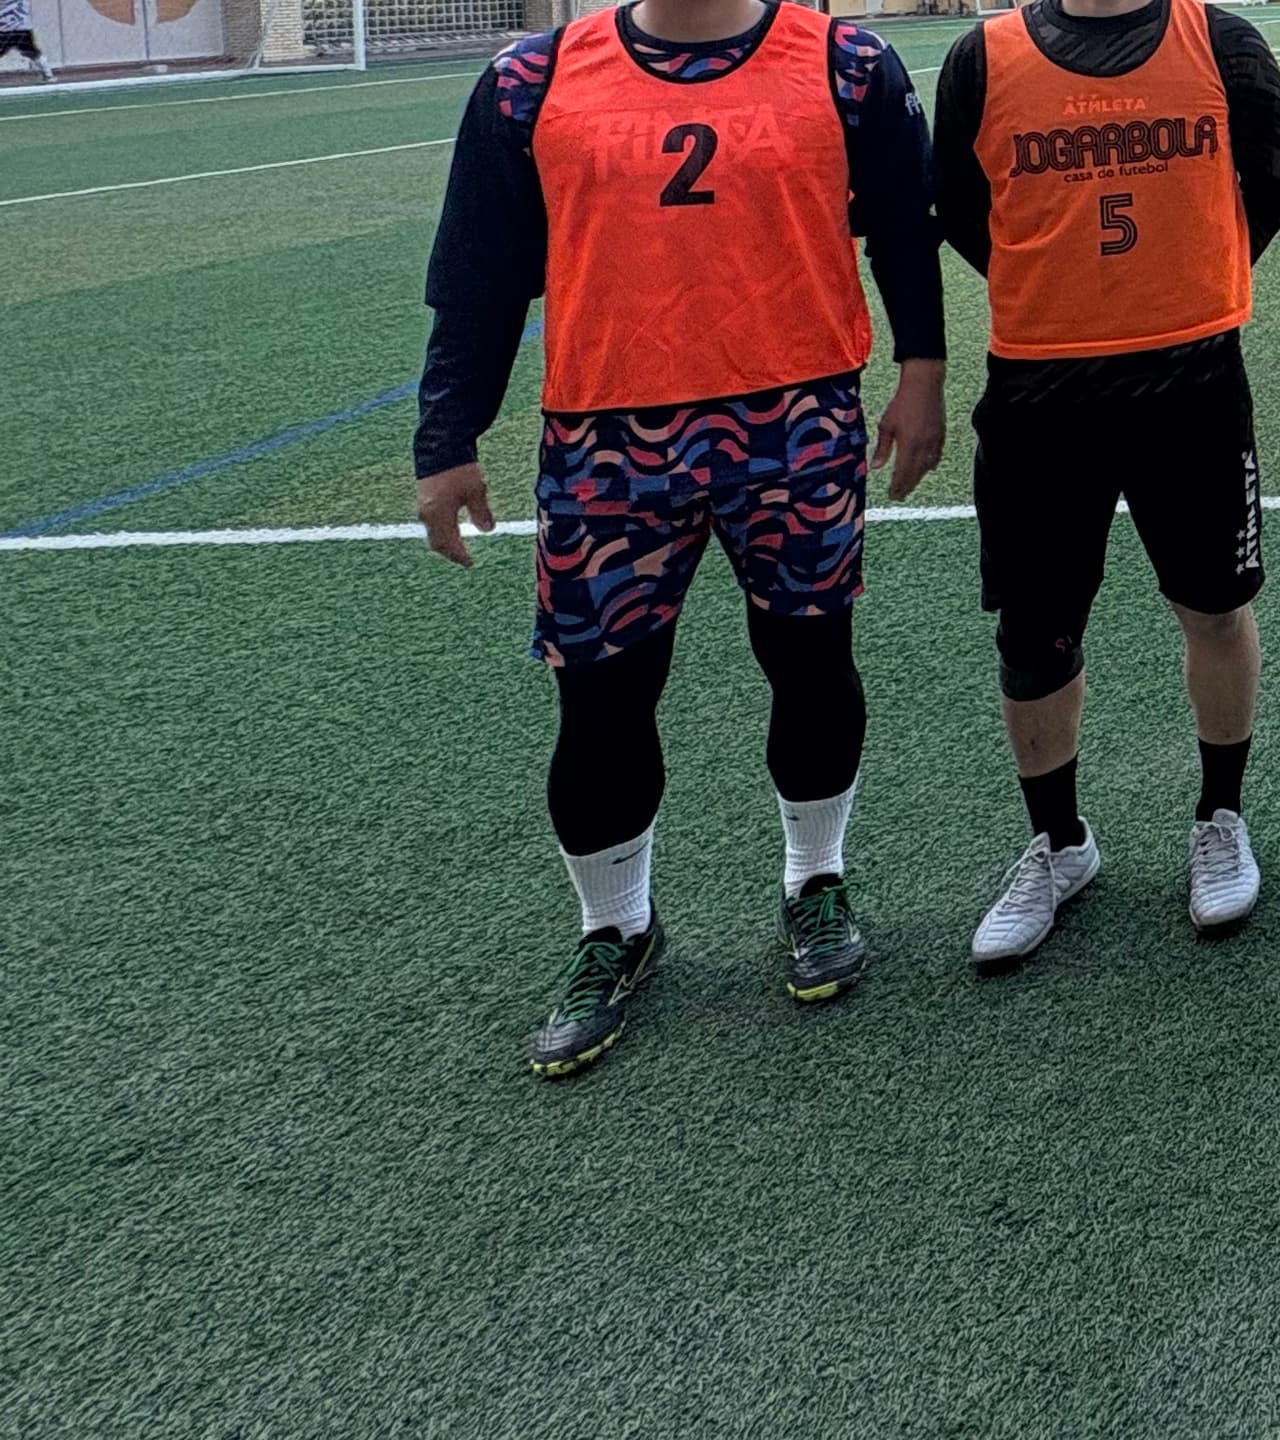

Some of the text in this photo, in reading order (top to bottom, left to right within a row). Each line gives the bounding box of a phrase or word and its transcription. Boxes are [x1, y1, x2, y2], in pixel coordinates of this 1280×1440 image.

[1062, 96, 1146, 116] ATHLETA
[659, 122, 719, 207] 2
[1009, 115, 1219, 179] JOGARBOLA
[1064, 160, 1169, 183] casa de futebol
[1100, 193, 1138, 256] 5
